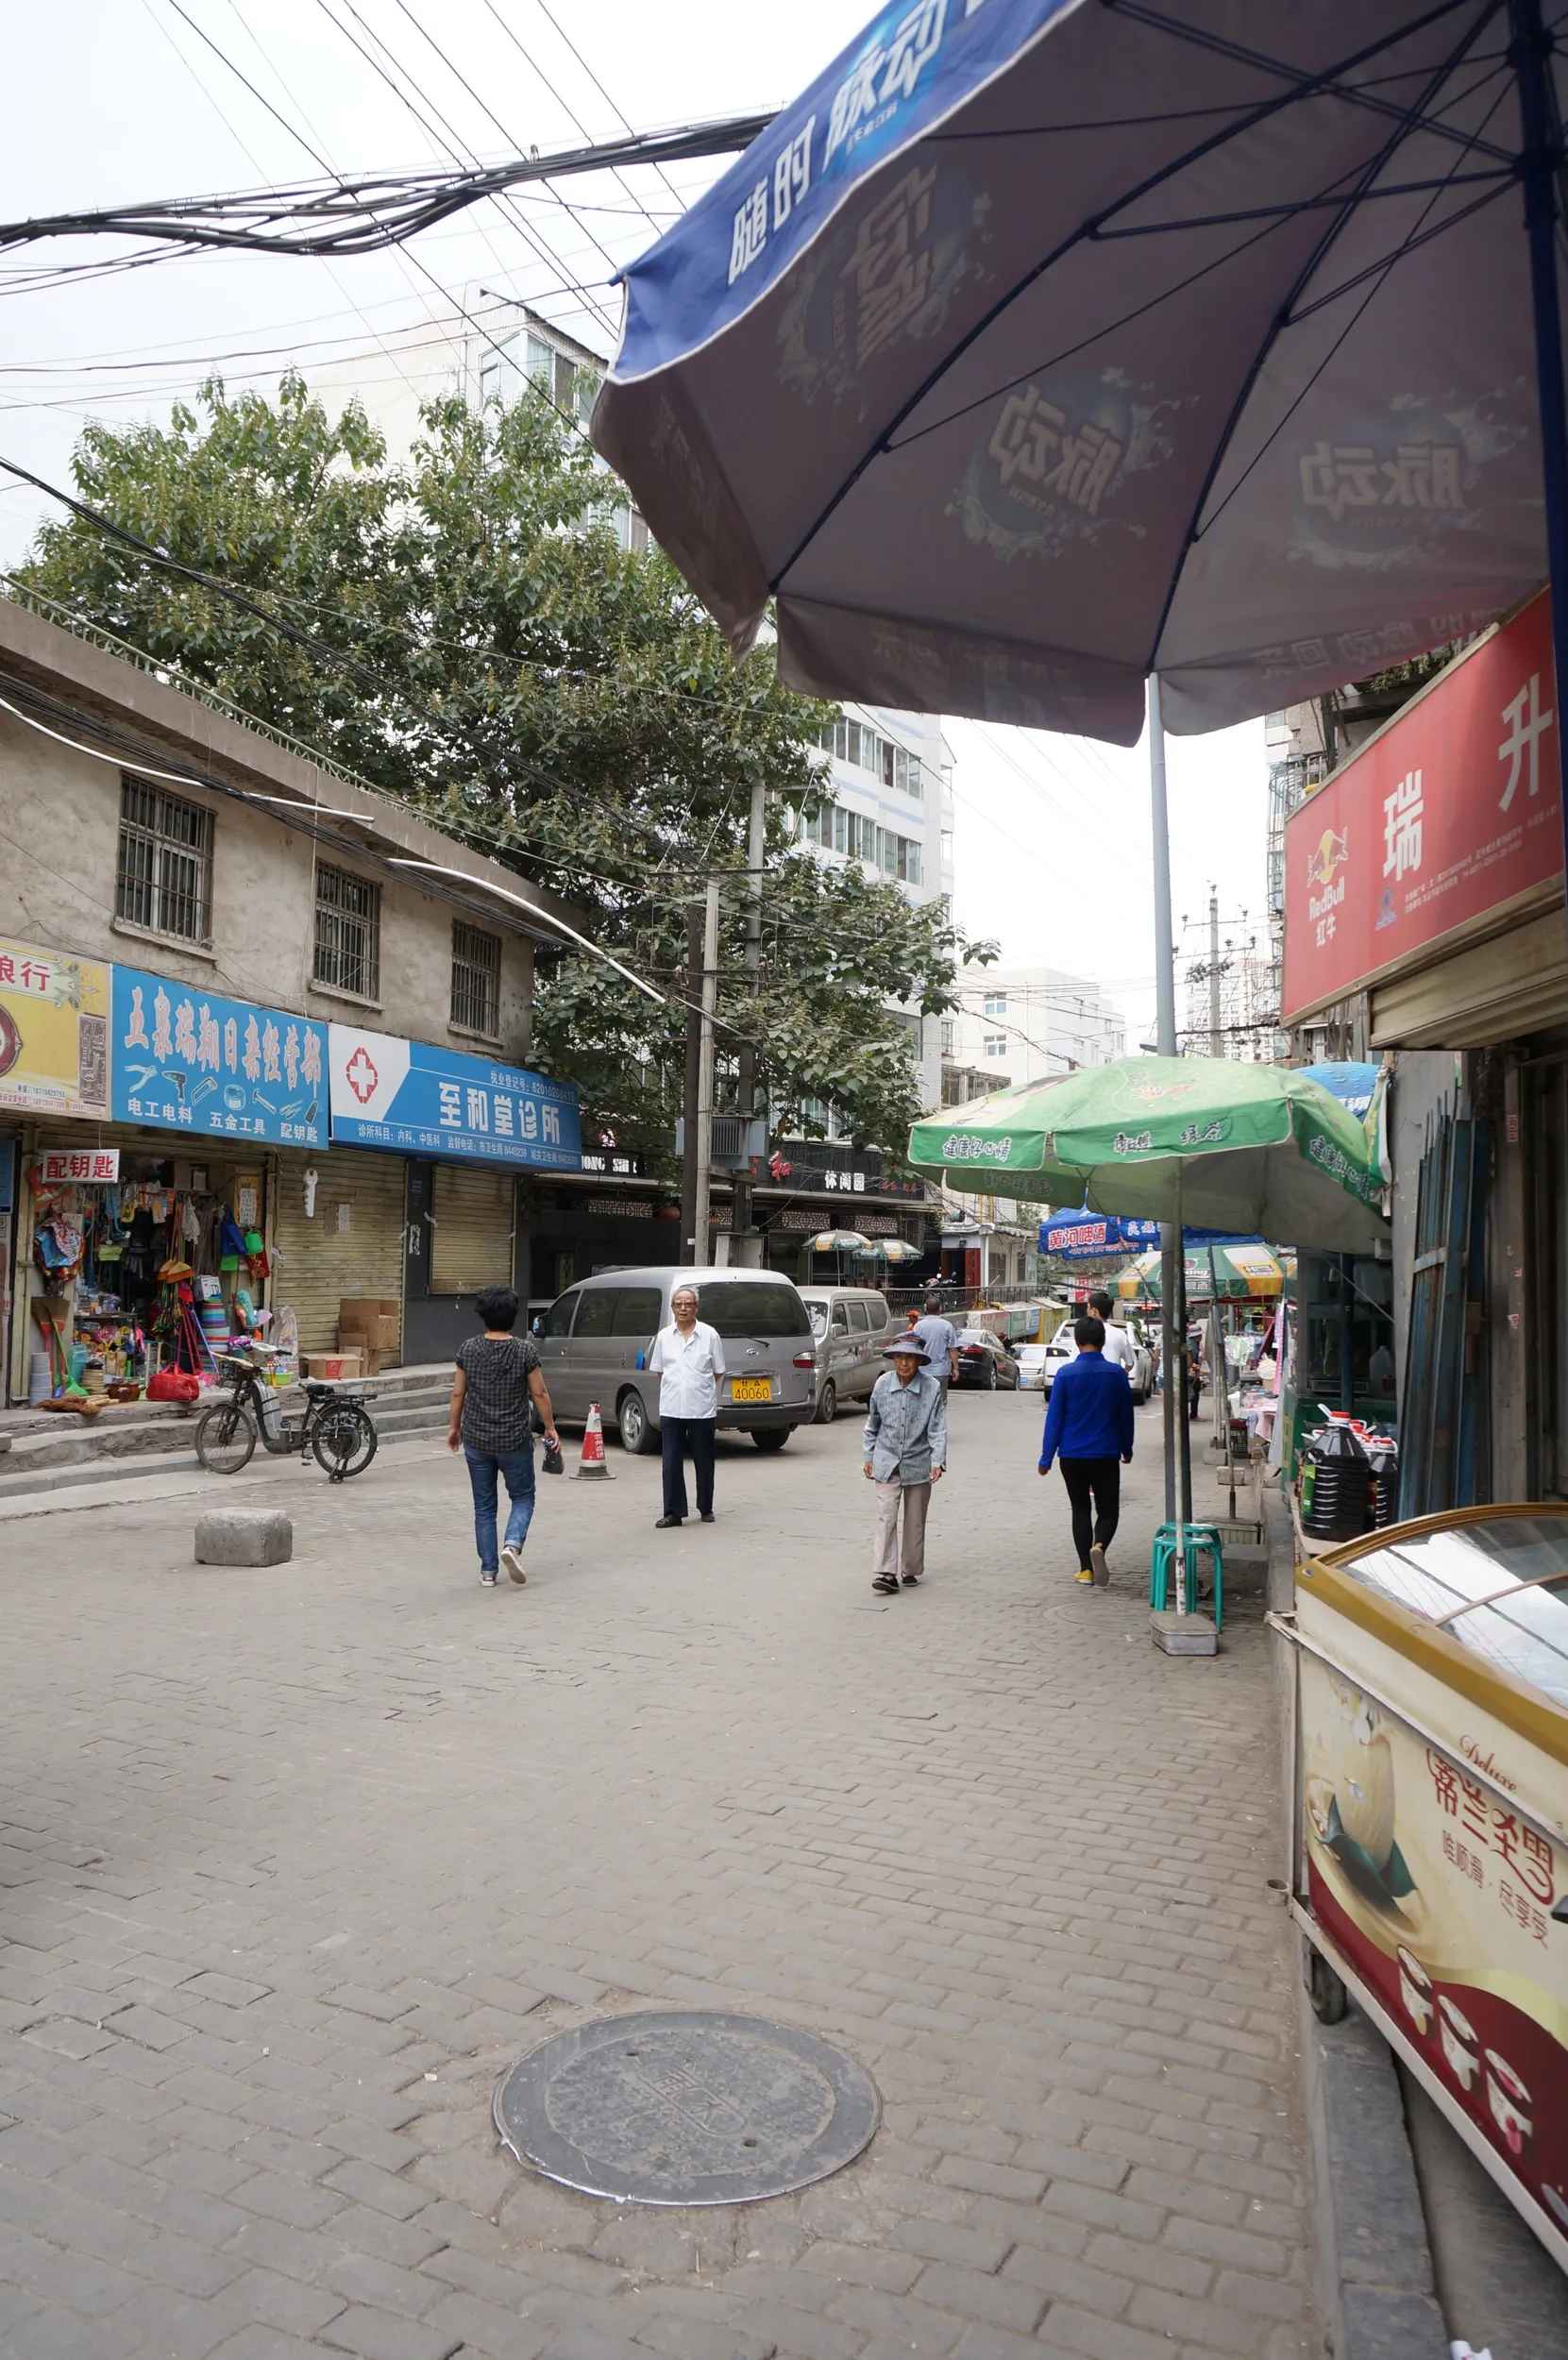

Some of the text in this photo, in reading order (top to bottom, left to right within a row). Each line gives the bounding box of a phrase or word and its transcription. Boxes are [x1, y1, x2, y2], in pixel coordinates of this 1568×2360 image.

[823, 0, 946, 174] 脉动
[1316, 913, 1337, 947] 红牛
[127, 1097, 318, 1143] 电工电料 五金工具 配钥匙
[439, 1082, 561, 1145] 至和堂诊所
[942, 1134, 1012, 1162] 健康好心情
[46, 1155, 114, 1179] 配钥匙
[1048, 1222, 1106, 1250] 黄河啤酒
[734, 1387, 769, 1400] 40060
[1459, 1734, 1518, 1793] Deluxe
